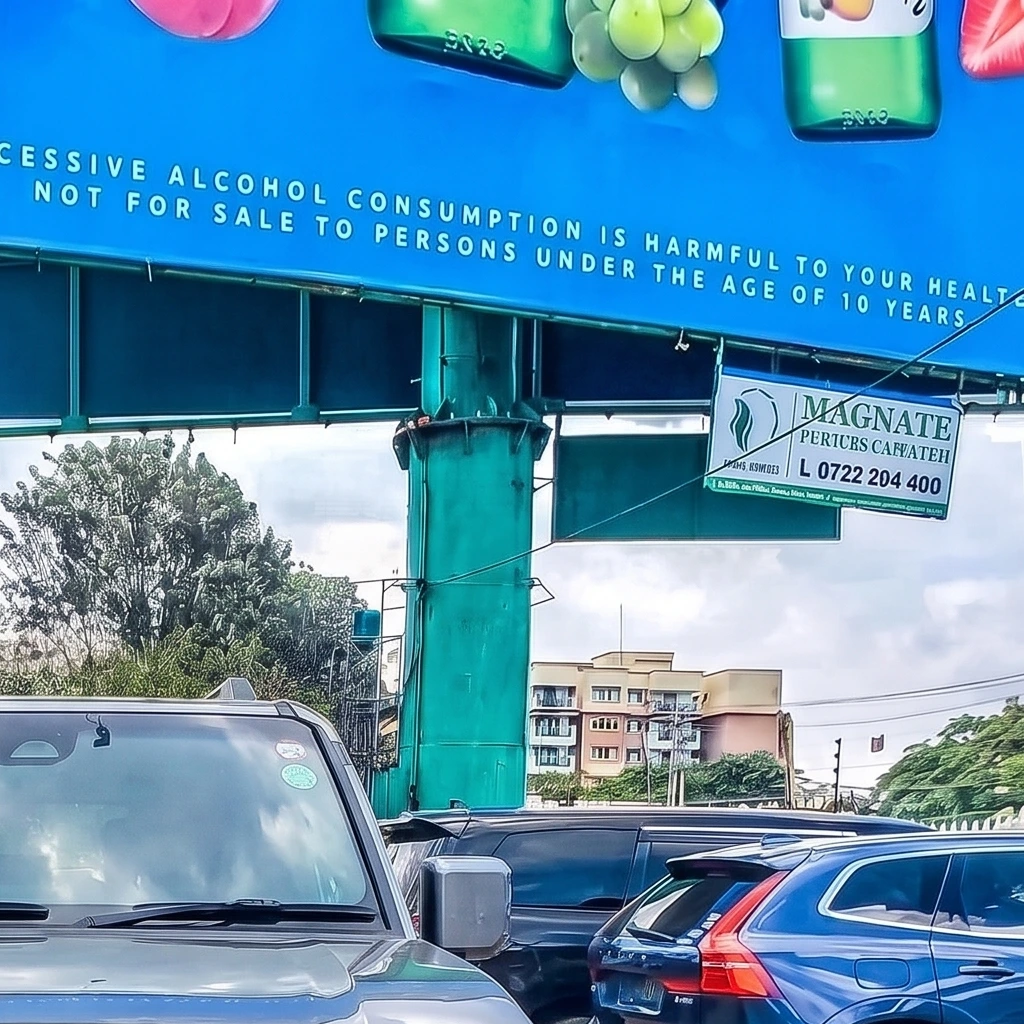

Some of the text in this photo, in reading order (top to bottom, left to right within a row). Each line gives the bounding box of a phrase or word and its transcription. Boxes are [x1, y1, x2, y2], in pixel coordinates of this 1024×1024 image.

[35, 180, 102, 208] NOT
[127, 191, 190, 219] FOR
[214, 203, 294, 232] SALE
[315, 215, 353, 239] TO
[375, 223, 516, 262] PERSONS
[537, 247, 636, 279] UNDER
[653, 263, 705, 289] THE
[722, 275, 776, 299] AGE
[792, 285, 825, 305] OF
[886, 299, 965, 328] YEARS
[168, 165, 327, 205] ALCOHOL
[348, 188, 581, 240] CONSUMPTION
[600, 224, 626, 248] IS
[645, 232, 780, 271] HARMFUL
[796, 256, 828, 279] TO
[843, 264, 913, 292] YOUR
[801, 394, 952, 442] MAGNATE
[818, 461, 864, 484] 0722
[867, 468, 902, 489] 204
[906, 474, 942, 495] 400
